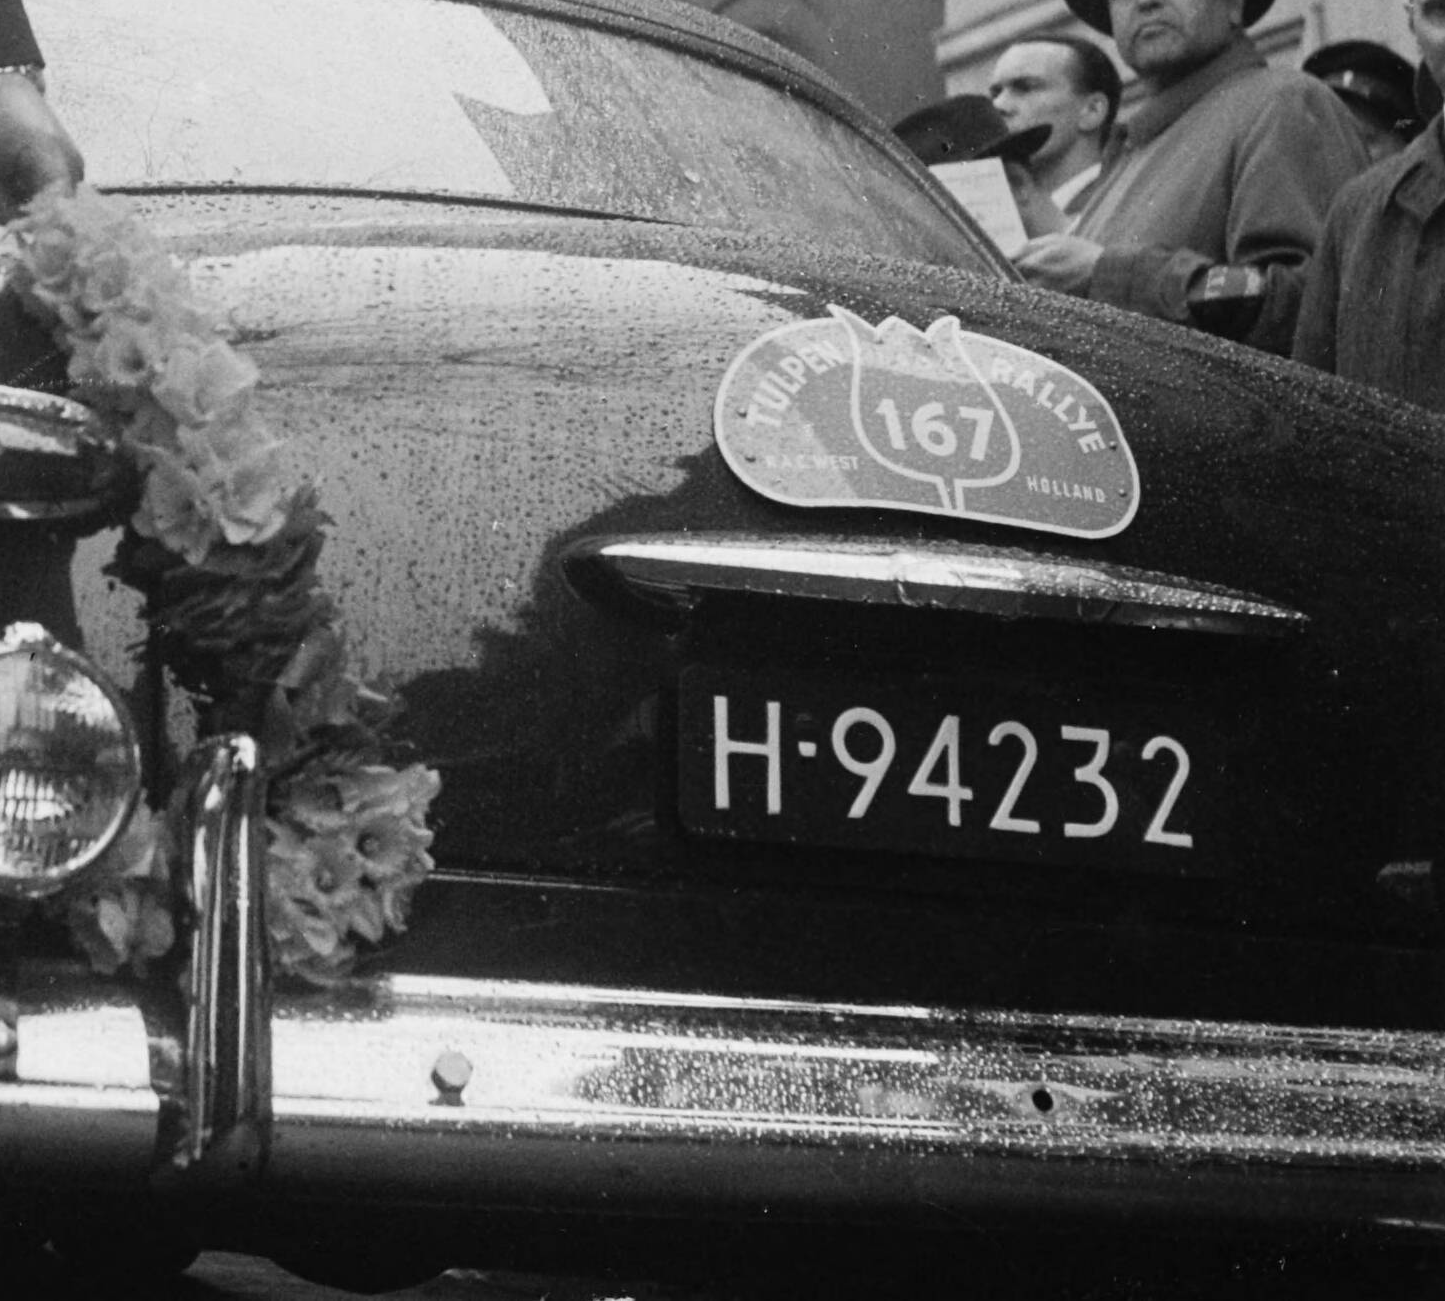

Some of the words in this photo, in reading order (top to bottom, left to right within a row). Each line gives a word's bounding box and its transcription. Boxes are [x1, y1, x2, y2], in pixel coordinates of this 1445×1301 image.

[746, 340, 847, 429] TULPEN
[991, 357, 1106, 454] RALLYE
[875, 398, 995, 462] 167
[1025, 474, 1107, 504] HOLLAND
[714, 696, 1193, 848] H-94232
